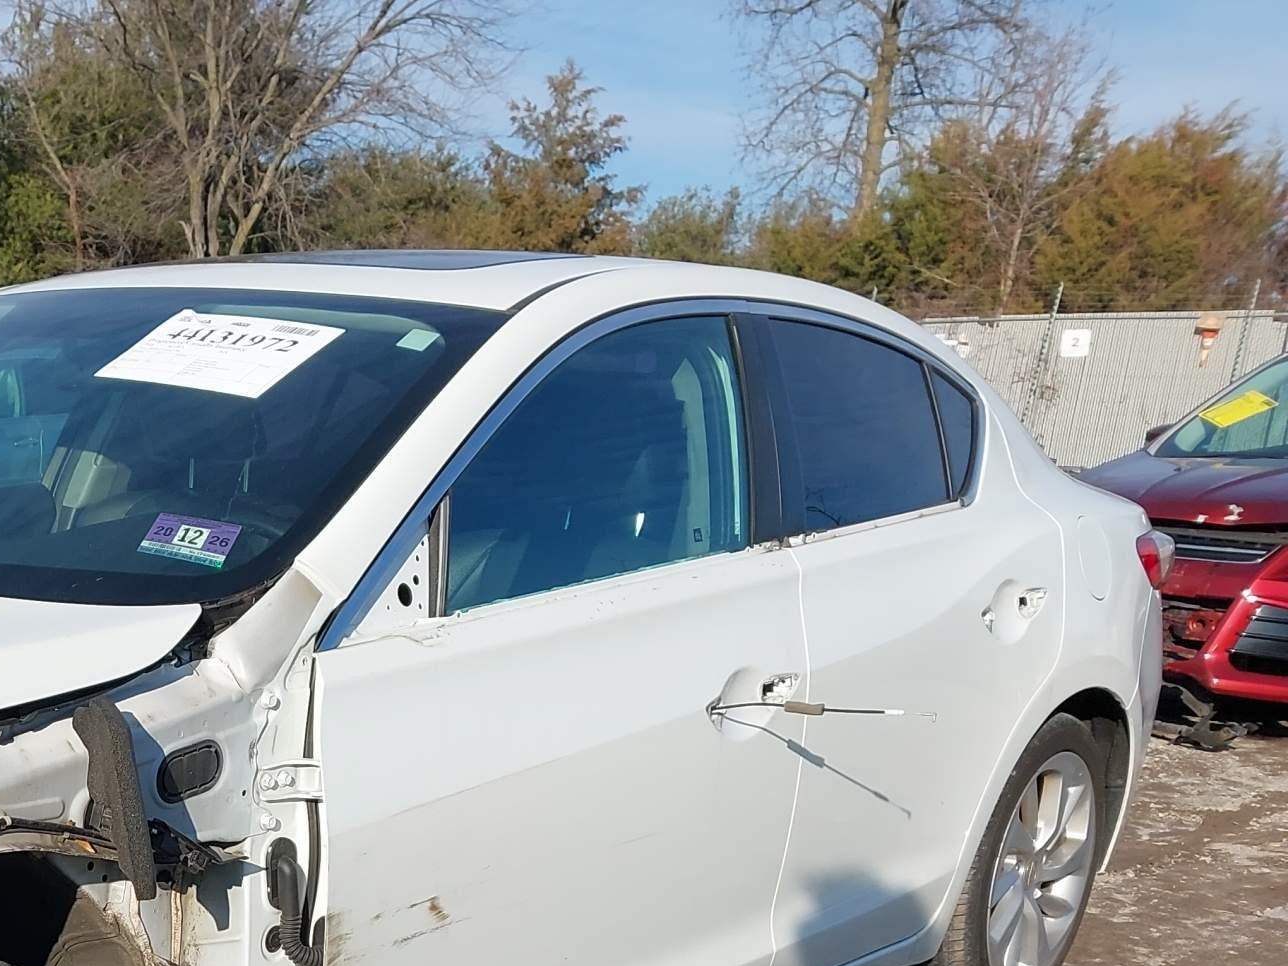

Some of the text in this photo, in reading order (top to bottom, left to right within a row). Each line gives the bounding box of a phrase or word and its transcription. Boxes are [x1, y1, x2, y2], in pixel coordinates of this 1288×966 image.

[167, 327, 300, 353] 44131972
[1071, 336, 1081, 348] 2
[153, 525, 231, 548] 20 12 26
